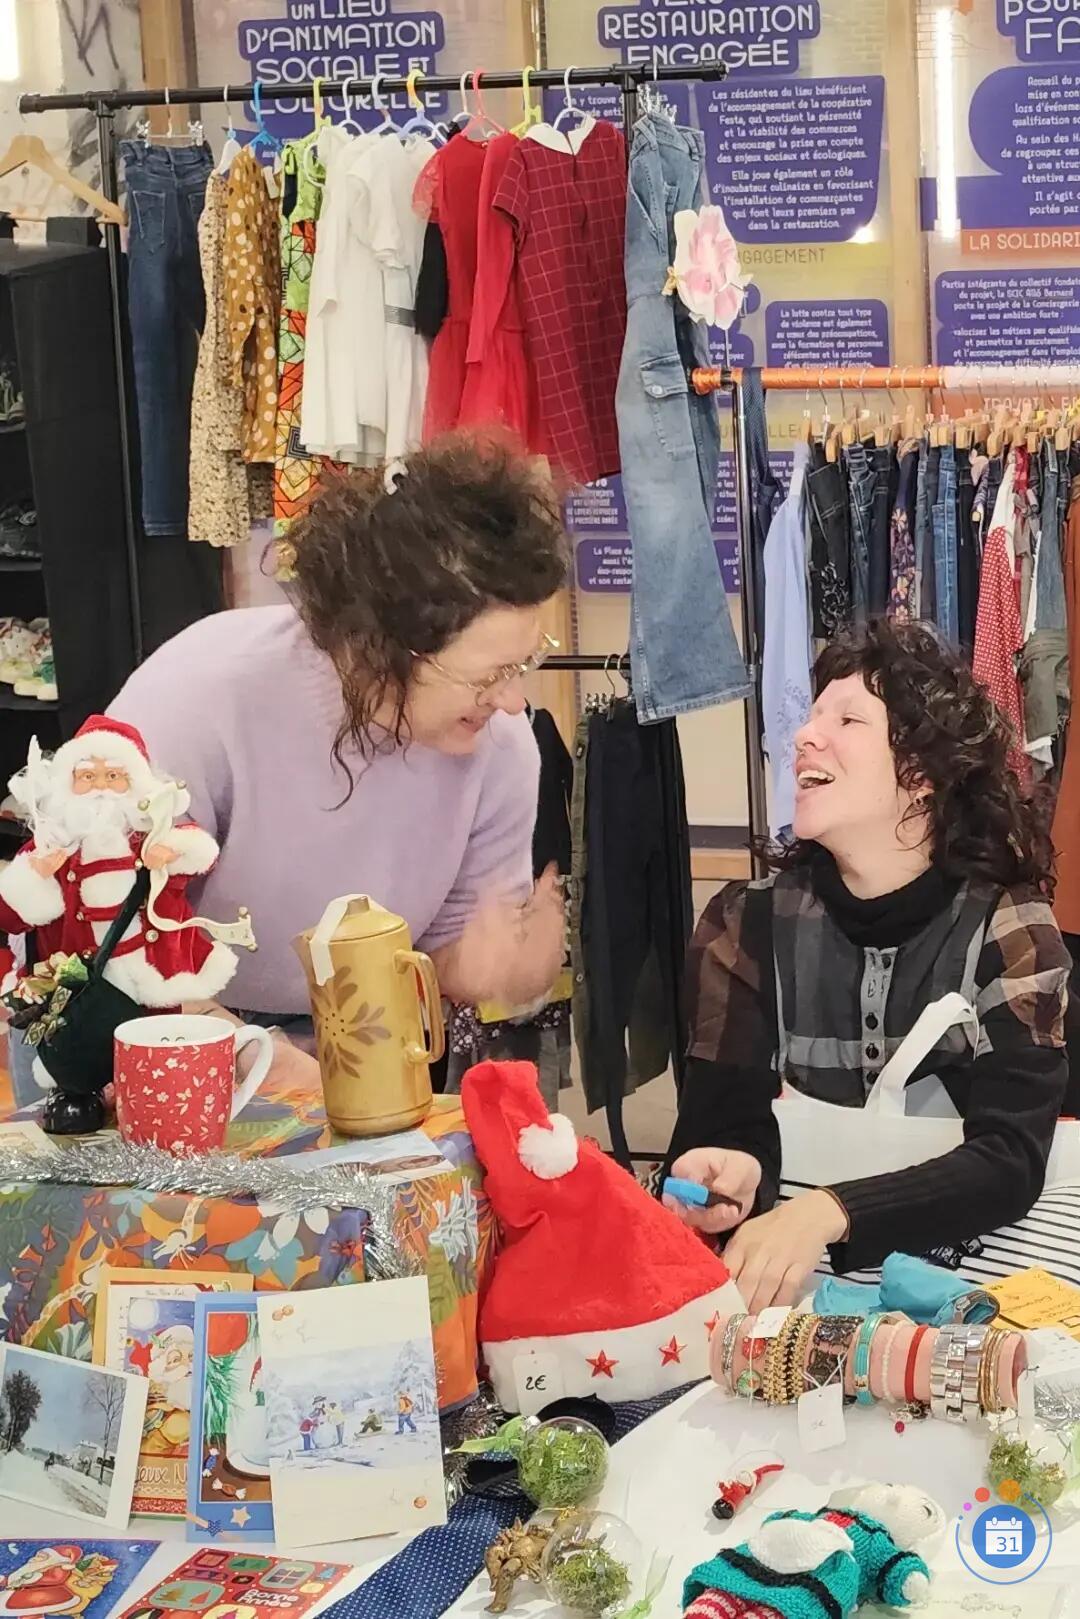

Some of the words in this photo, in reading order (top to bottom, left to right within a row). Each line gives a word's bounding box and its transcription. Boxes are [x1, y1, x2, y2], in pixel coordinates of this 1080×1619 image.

[291, 3, 316, 20] UN
[320, 0, 387, 19] LIEU
[603, 4, 814, 40] RESTAURATION
[246, 20, 437, 54] D'ANIMATION
[627, 35, 790, 68] ENGAGÉE
[255, 53, 401, 84] SOCIALE
[712, 90, 727, 100] Les
[782, 87, 792, 97] du
[795, 86, 812, 96] lieu
[816, 84, 867, 95] bénéficient
[708, 103, 718, 112] de
[721, 101, 796, 112] l'accompagnement
[798, 99, 808, 109] de
[811, 98, 820, 108] la
[822, 98, 872, 109] coopérative
[719, 116, 746, 126] Festa,
[748, 115, 762, 126] qui
[766, 113, 804, 123] soutient
[807, 112, 816, 122] la
[819, 110, 862, 122] pérennité
[1012, 115, 1070, 128] qualification
[724, 128, 734, 137] et
[738, 127, 746, 137] la
[749, 126, 788, 136] viabilité
[791, 125, 805, 135] des
[809, 124, 857, 134] commerces
[720, 142, 729, 150] et
[732, 141, 776, 152] encourage
[779, 138, 787, 148] la
[790, 139, 814, 149] prise
[830, 137, 863, 148] compte
[717, 153, 731, 163] des
[735, 153, 761, 164] enjeux
[764, 152, 797, 161] sociaux
[800, 152, 810, 160] et
[1001, 148, 1012, 158] de
[732, 171, 749, 180] Elle
[752, 170, 770, 181] joue
[774, 169, 817, 181] également
[820, 169, 831, 177] un
[834, 167, 853, 177] rôle
[713, 184, 766, 194] d'incubateur
[770, 182, 810, 191] culinaire
[813, 182, 824, 190] en
[827, 180, 873, 190] favorisant
[724, 196, 783, 206] l'installation
[786, 195, 797, 204] de
[732, 210, 746, 219] qui
[750, 207, 769, 217] font
[772, 207, 794, 217] leurs
[798, 206, 837, 218] premiers
[841, 207, 855, 217] pas
[748, 221, 768, 230] dans
[771, 220, 780, 230] la
[970, 234, 990, 250] LA
[738, 248, 825, 264] GAGEMENT
[526, 1374, 546, 1390] 2€
[244, 1588, 299, 1602] Bonne
